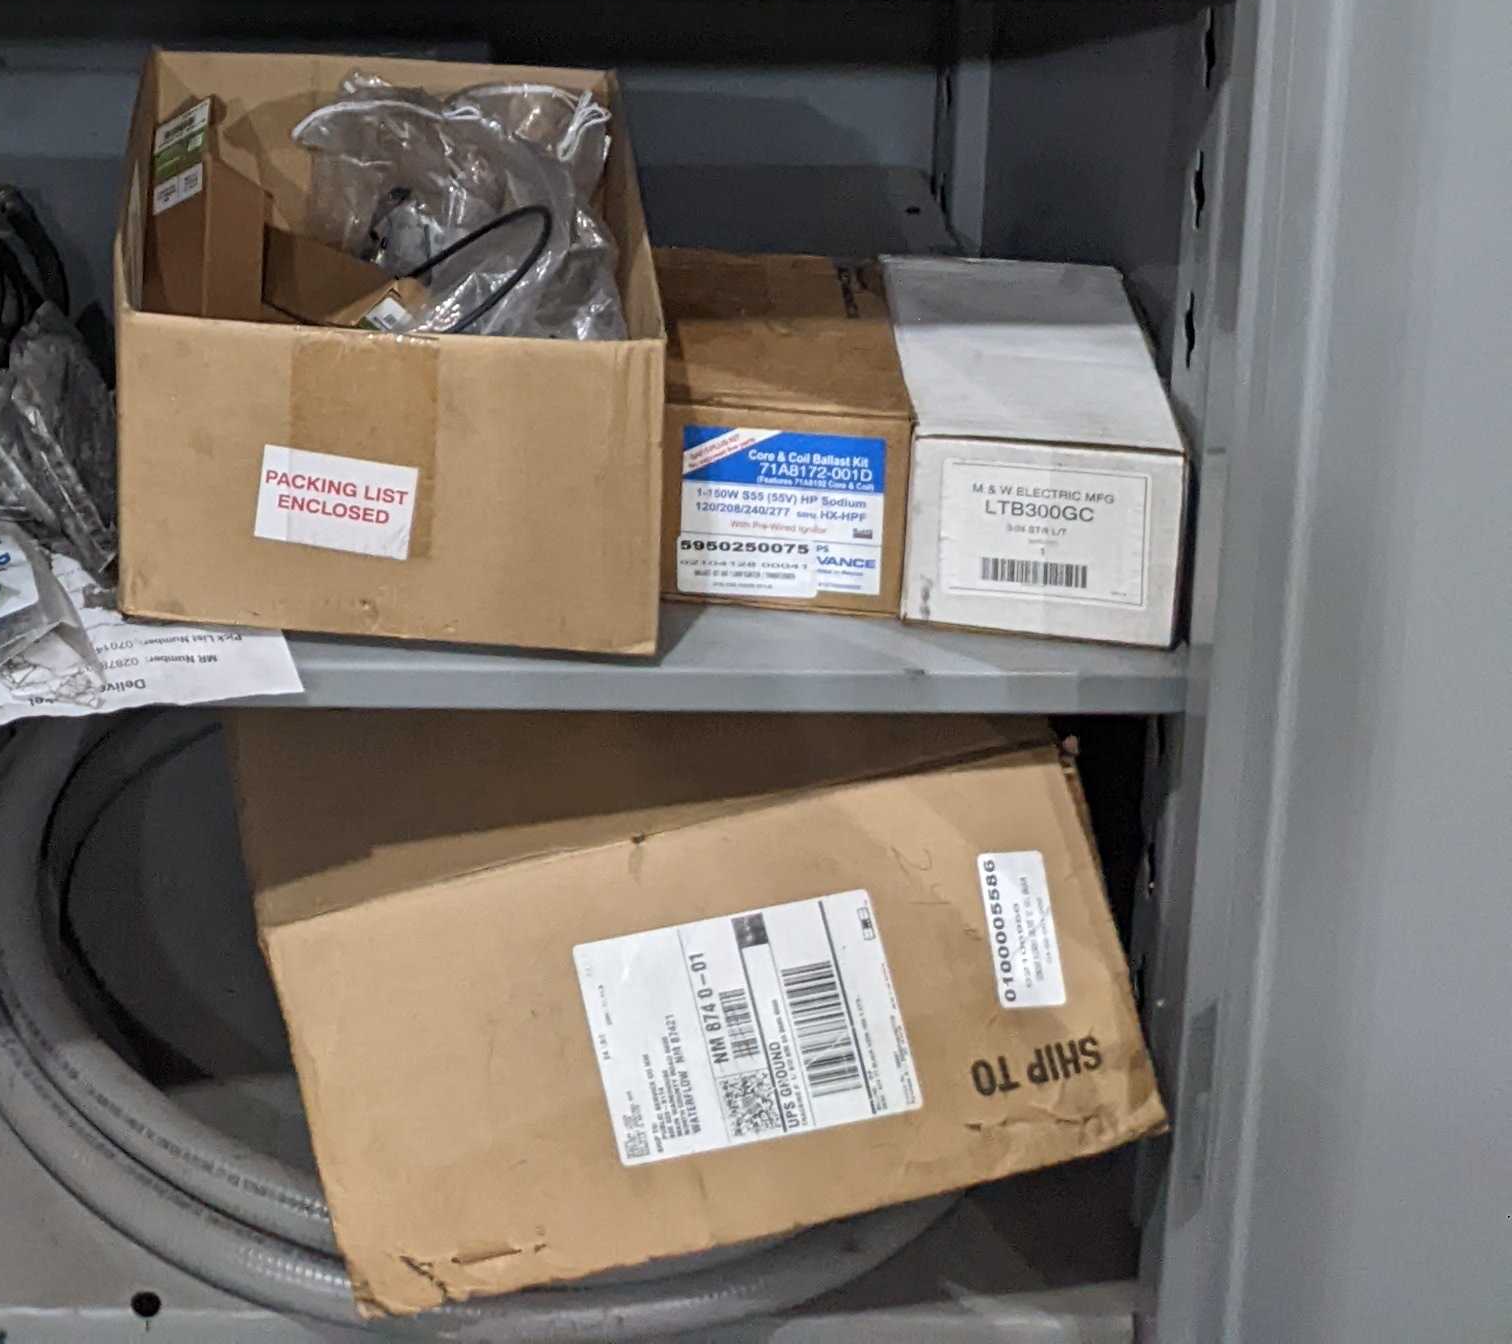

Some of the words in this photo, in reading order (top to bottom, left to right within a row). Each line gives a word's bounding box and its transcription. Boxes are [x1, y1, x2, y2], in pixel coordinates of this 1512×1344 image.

[748, 449, 775, 461] Core
[778, 451, 785, 462] &
[788, 452, 810, 462] Coil
[812, 453, 849, 464] Ballast
[853, 457, 869, 468] Kit
[760, 462, 872, 481] 71A8172-001D
[266, 469, 358, 500] PACKING
[364, 483, 409, 506] LIST
[696, 488, 739, 498] 1-150W
[742, 490, 764, 501] S55
[767, 492, 797, 505] (55V)
[801, 495, 818, 504] HP
[822, 496, 867, 508] Sodium
[972, 483, 984, 494] M
[987, 484, 997, 495] &
[1000, 485, 1013, 496] W
[1016, 486, 1082, 501] ELECTRIC
[1085, 490, 1115, 505] MFG
[277, 494, 390, 527] ENCLOSED
[696, 502, 790, 517] 120/208/240/277
[820, 511, 867, 522] HX-HPF
[984, 499, 1095, 522] LTB300GC
[680, 540, 809, 554] 5950250075
[816, 556, 876, 568] VANCE
[196, 652, 217, 664] MR
[985, 859, 1017, 1002] 0100005586
[700, 1003, 721, 1032] 874
[707, 1036, 729, 1064] NM
[1027, 1034, 1103, 1086] SHIP
[972, 1055, 1021, 1097] TO
[677, 1069, 701, 1133] WATERFLOW
[782, 1099, 800, 1129] UPS
